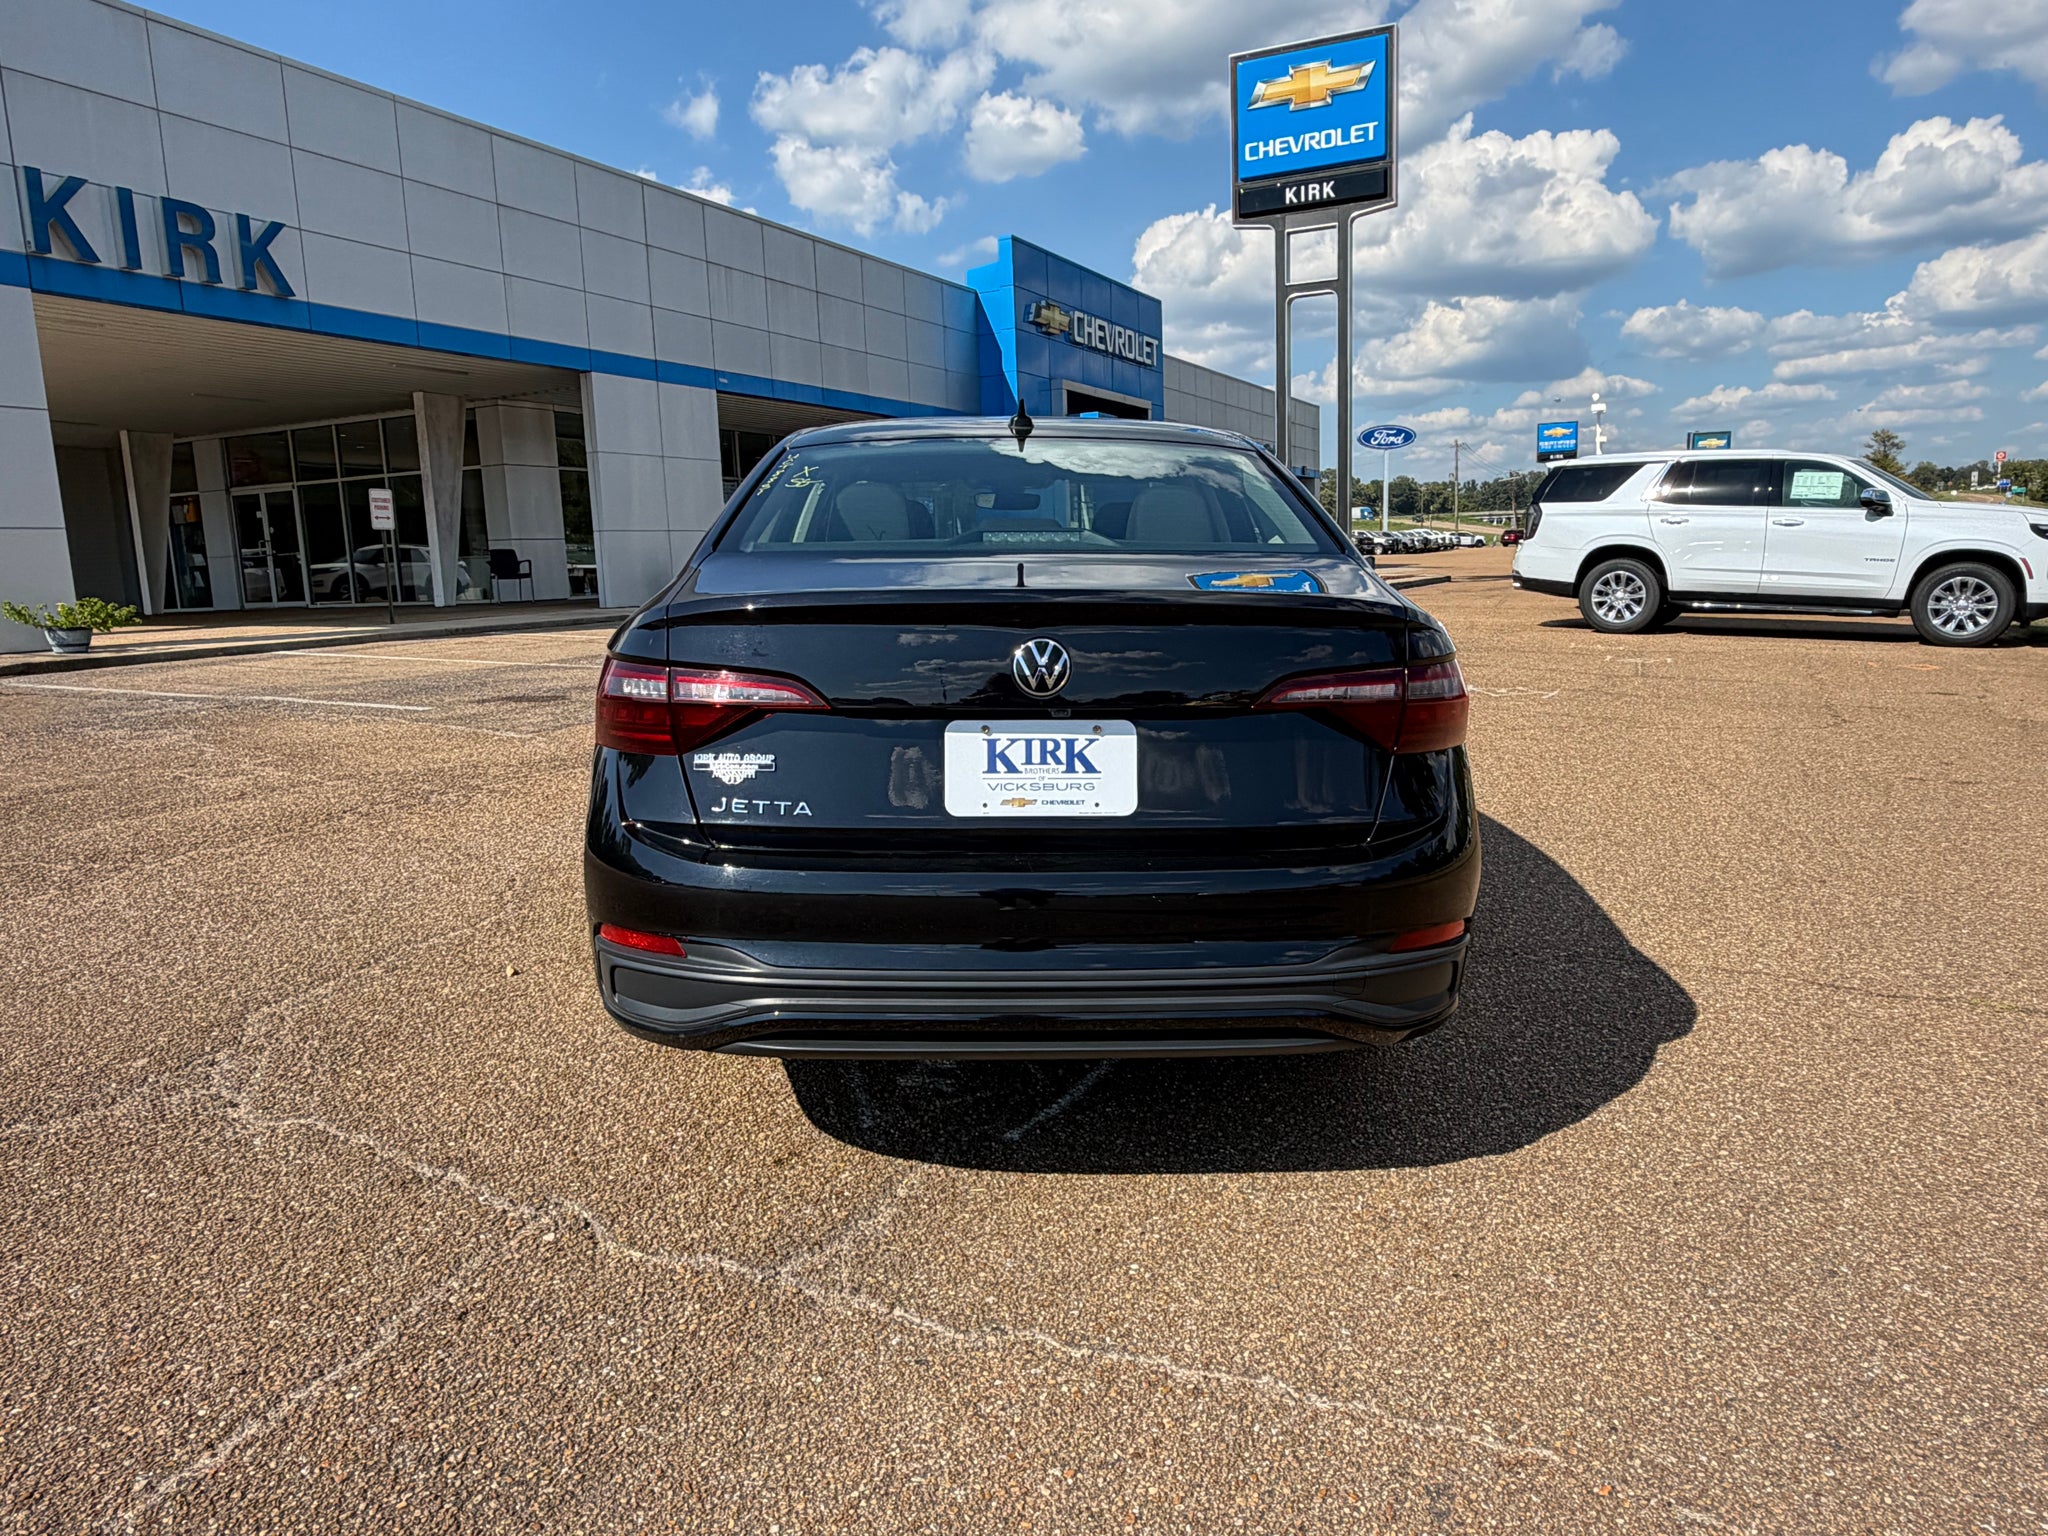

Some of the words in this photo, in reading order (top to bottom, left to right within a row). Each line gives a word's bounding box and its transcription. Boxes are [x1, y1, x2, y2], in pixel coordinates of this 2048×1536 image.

[1244, 121, 1379, 162] CHEVROLET
[1285, 181, 1336, 204] KIRK
[22, 165, 297, 297] KIRK
[1072, 310, 1159, 366] CHEVROLET
[1370, 429, 1406, 445] Ford
[693, 753, 716, 763] KIRK
[717, 753, 741, 763] AUTO
[743, 754, 776, 764] GROUP
[981, 738, 1102, 774] KIRK
[1024, 767, 1061, 775] BROTHERS
[987, 782, 1096, 792] VICKSBURG
[711, 797, 813, 817] JETTA
